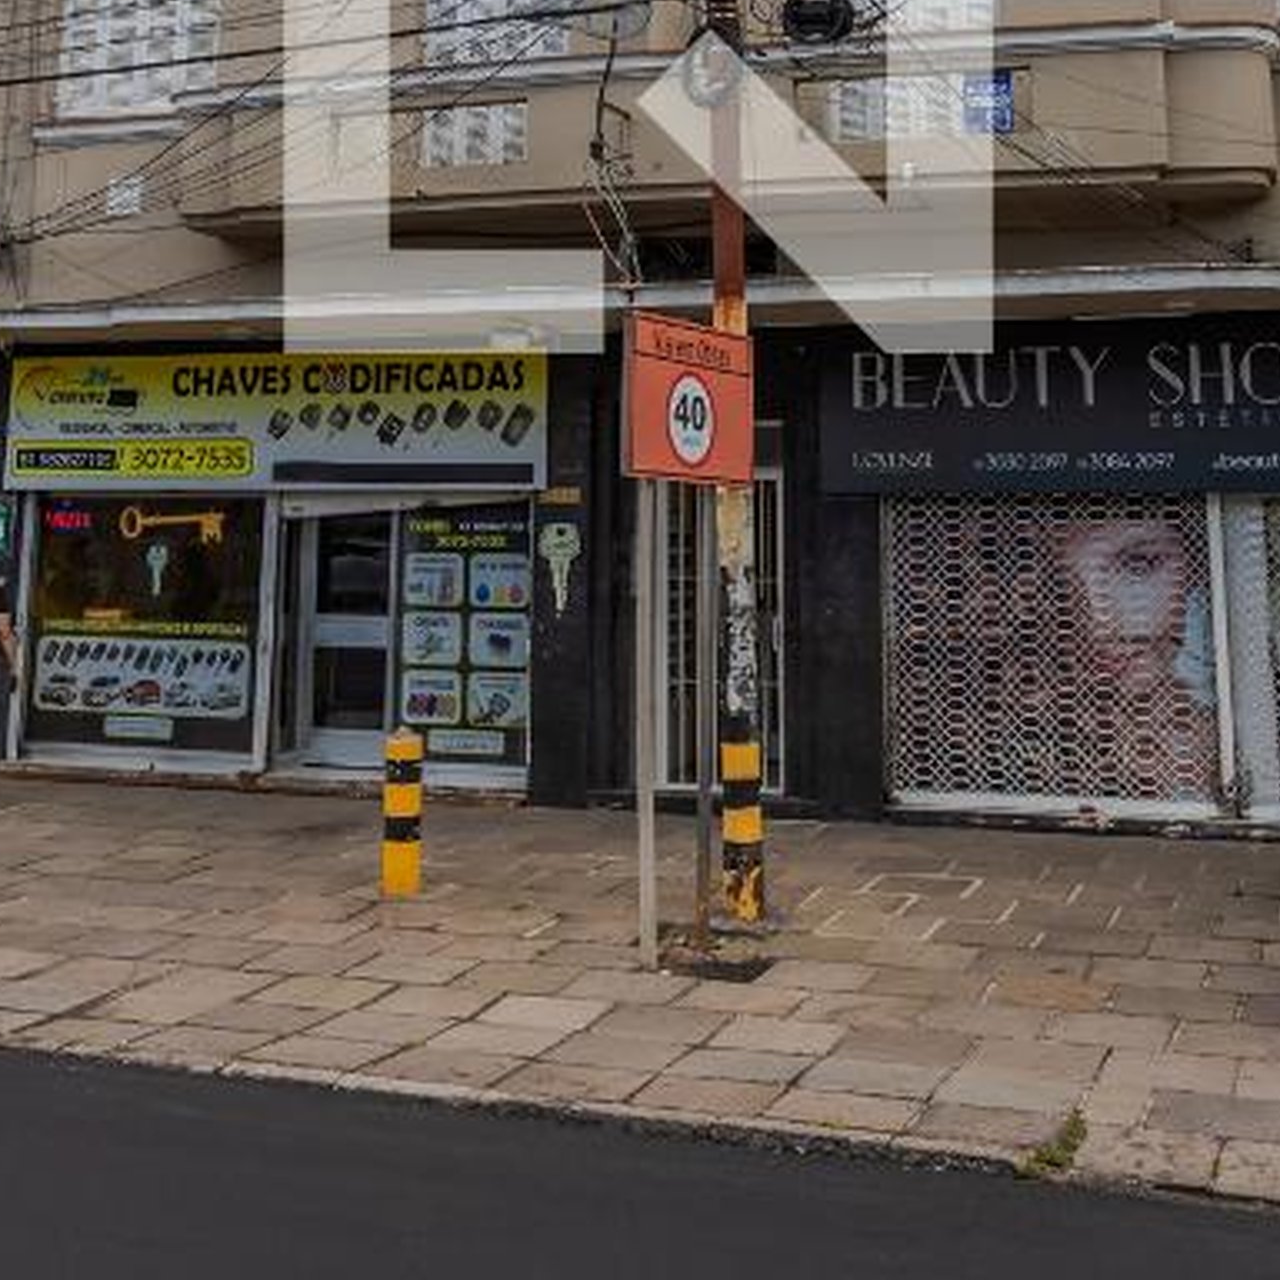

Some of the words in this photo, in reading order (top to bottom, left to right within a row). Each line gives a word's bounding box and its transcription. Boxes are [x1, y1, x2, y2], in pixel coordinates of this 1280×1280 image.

[172, 364, 291, 397] CHAVES
[852, 345, 1110, 410] BEAUTY
[673, 393, 706, 431] 40
